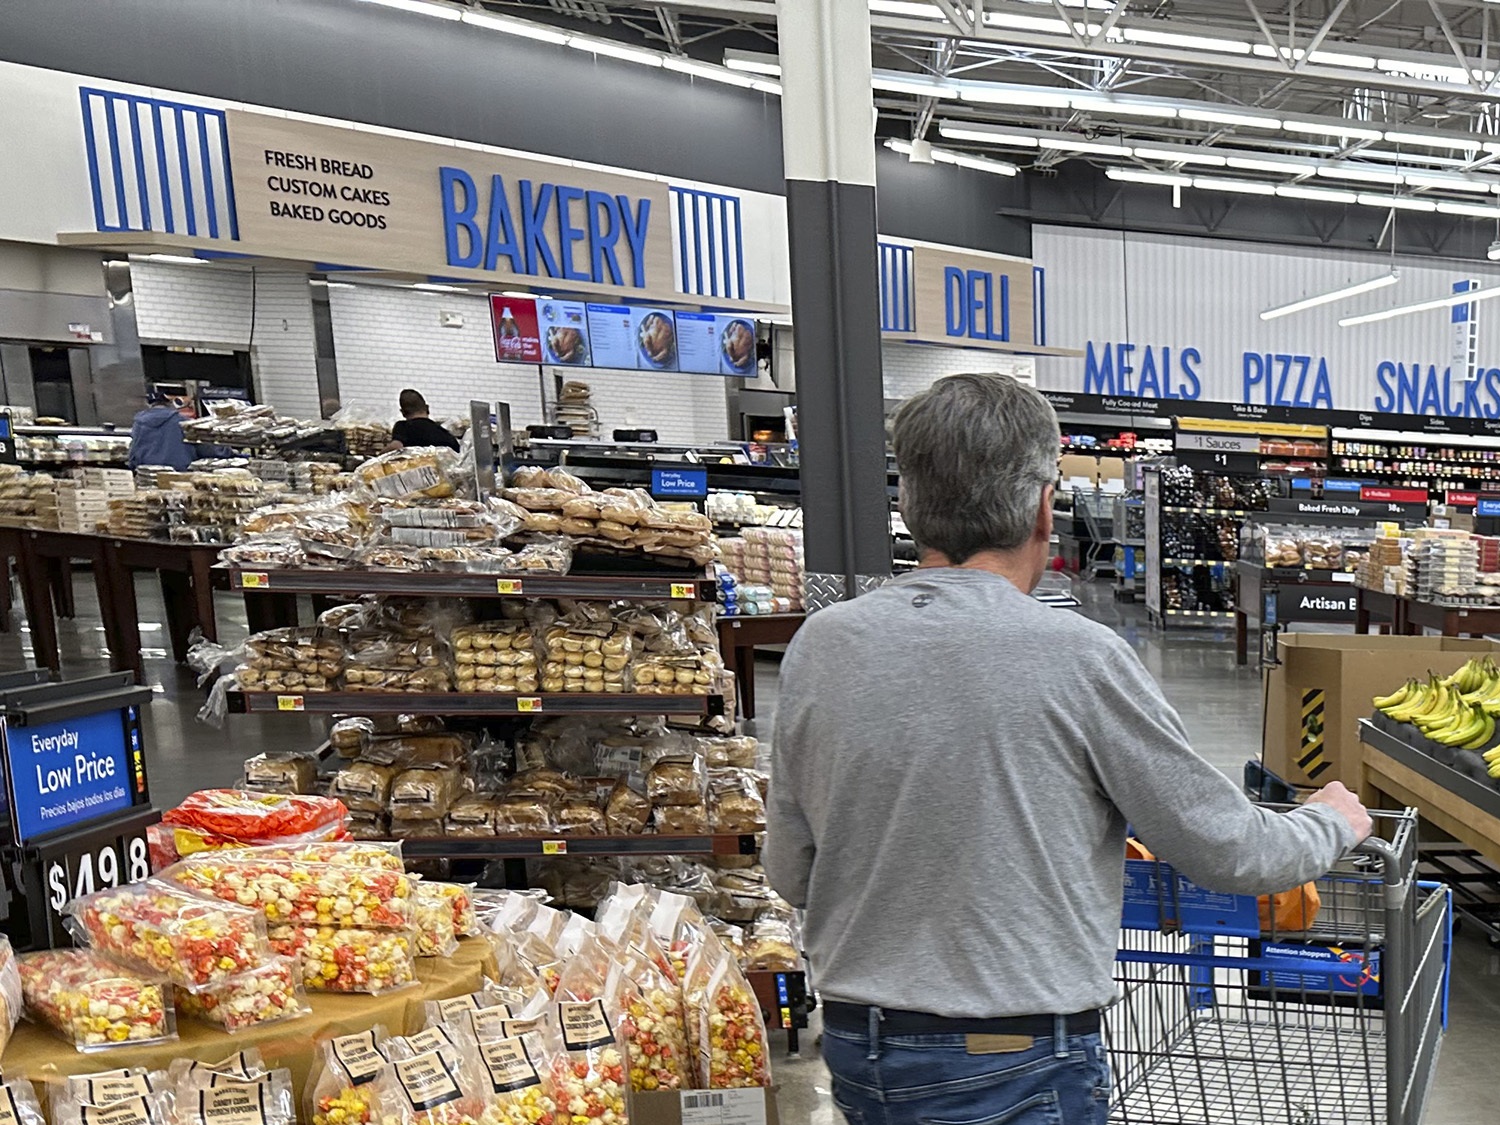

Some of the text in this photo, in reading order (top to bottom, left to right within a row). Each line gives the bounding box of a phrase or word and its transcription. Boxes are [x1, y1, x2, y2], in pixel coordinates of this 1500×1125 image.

[264, 150, 374, 179] FRESH BREAD
[267, 176, 391, 206] CUSTOM CAKES
[270, 201, 387, 229] BAKED GOODS
[439, 166, 651, 288] BAKERY
[945, 266, 1010, 343] DELI
[1084, 342, 1201, 400] MEALS
[1242, 352, 1333, 410] PIZZA
[1142, 401, 1158, 409] Meat
[1232, 404, 1267, 414] Take & Bake
[1359, 412, 1445, 426] Dips Sides
[1206, 437, 1242, 450] Sauces
[1215, 453, 1228, 466] $1
[661, 479, 696, 488] Low Price
[1299, 503, 1360, 516] Baked Fresh Daily
[1300, 596, 1346, 610] Artisan
[31, 729, 79, 754] Everyday
[36, 752, 115, 795] Low Price
[40, 805, 67, 820] Precios
[67, 798, 85, 814] bajos
[85, 793, 104, 807] todos
[103, 790, 113, 801] los
[1265, 946, 1299, 956] Attention
[1299, 949, 1331, 958] shoppers
[234, 1095, 250, 1104] CORN
[230, 1104, 258, 1114] POPCORN
[119, 1112, 137, 1121] CORN
